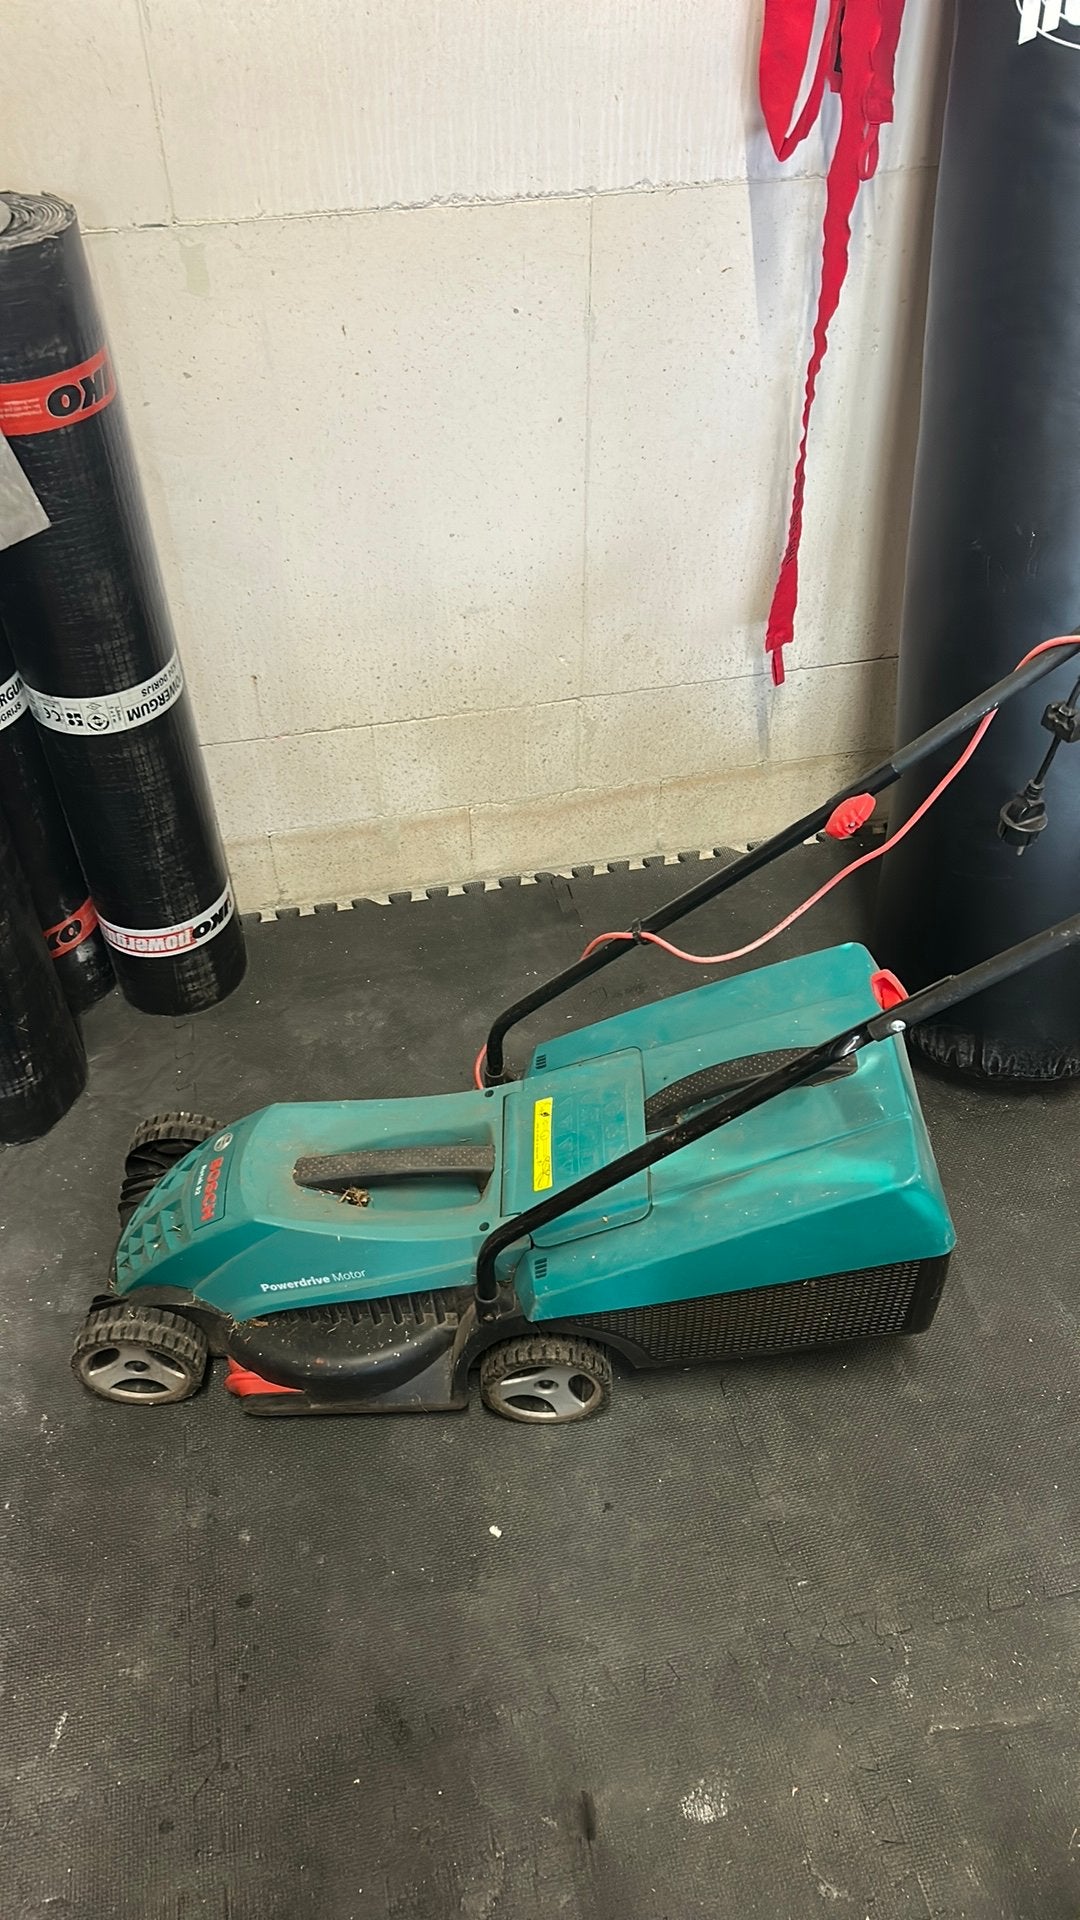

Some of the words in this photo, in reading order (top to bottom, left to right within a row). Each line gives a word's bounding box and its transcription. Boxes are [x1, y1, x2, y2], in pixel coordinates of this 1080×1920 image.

[0, 677, 24, 707] RGUM
[0, 701, 22, 723] GRIJS
[201, 1156, 224, 1221] BOSCH
[260, 1276, 331, 1292] Powerdrive
[331, 1270, 366, 1282] Motor
